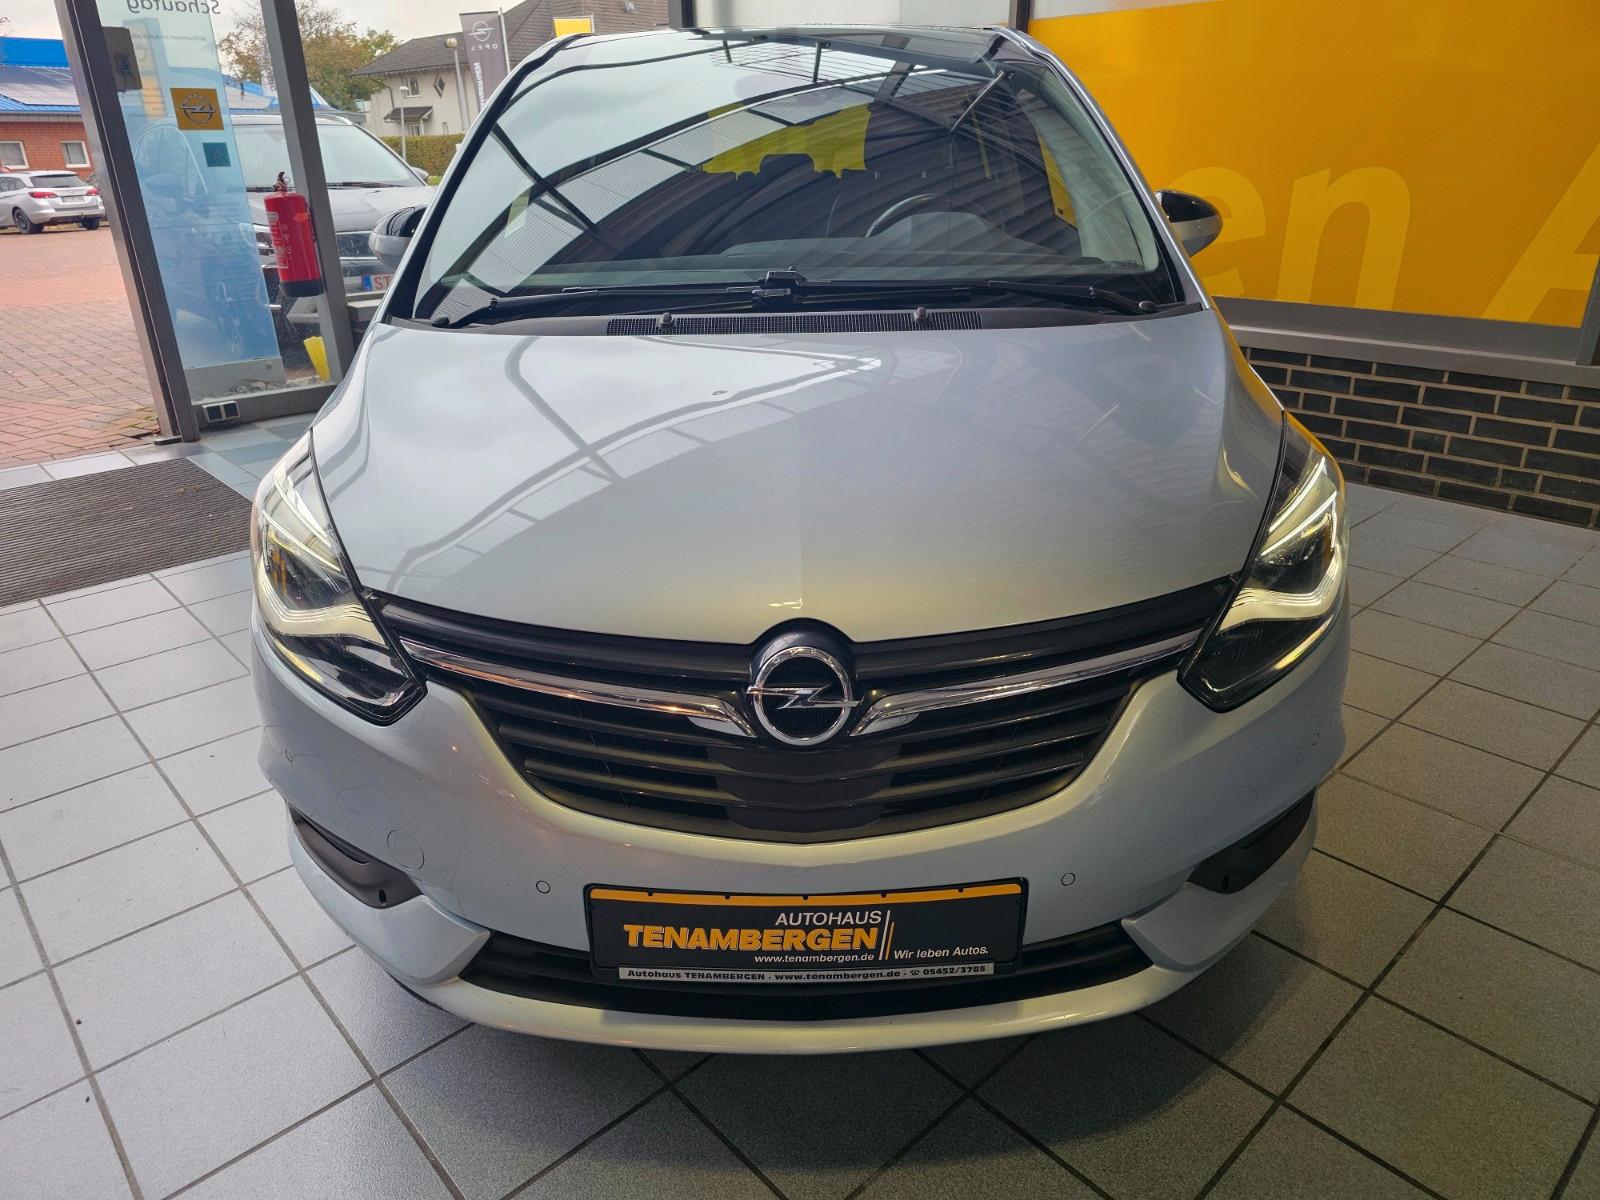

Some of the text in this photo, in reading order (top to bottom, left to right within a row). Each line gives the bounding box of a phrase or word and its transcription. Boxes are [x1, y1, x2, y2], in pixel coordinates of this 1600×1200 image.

[772, 647, 834, 664] OPEL
[775, 910, 882, 926] AUTOHAUS
[623, 924, 878, 951] TENAMBERGEN
[754, 952, 874, 964] www.tenambergen.de
[893, 945, 989, 960] Wir leben Autos.
[627, 970, 681, 979] Autohaus
[685, 972, 765, 980] TENAMBERGEN
[774, 970, 901, 981] www.tenambergen.de
